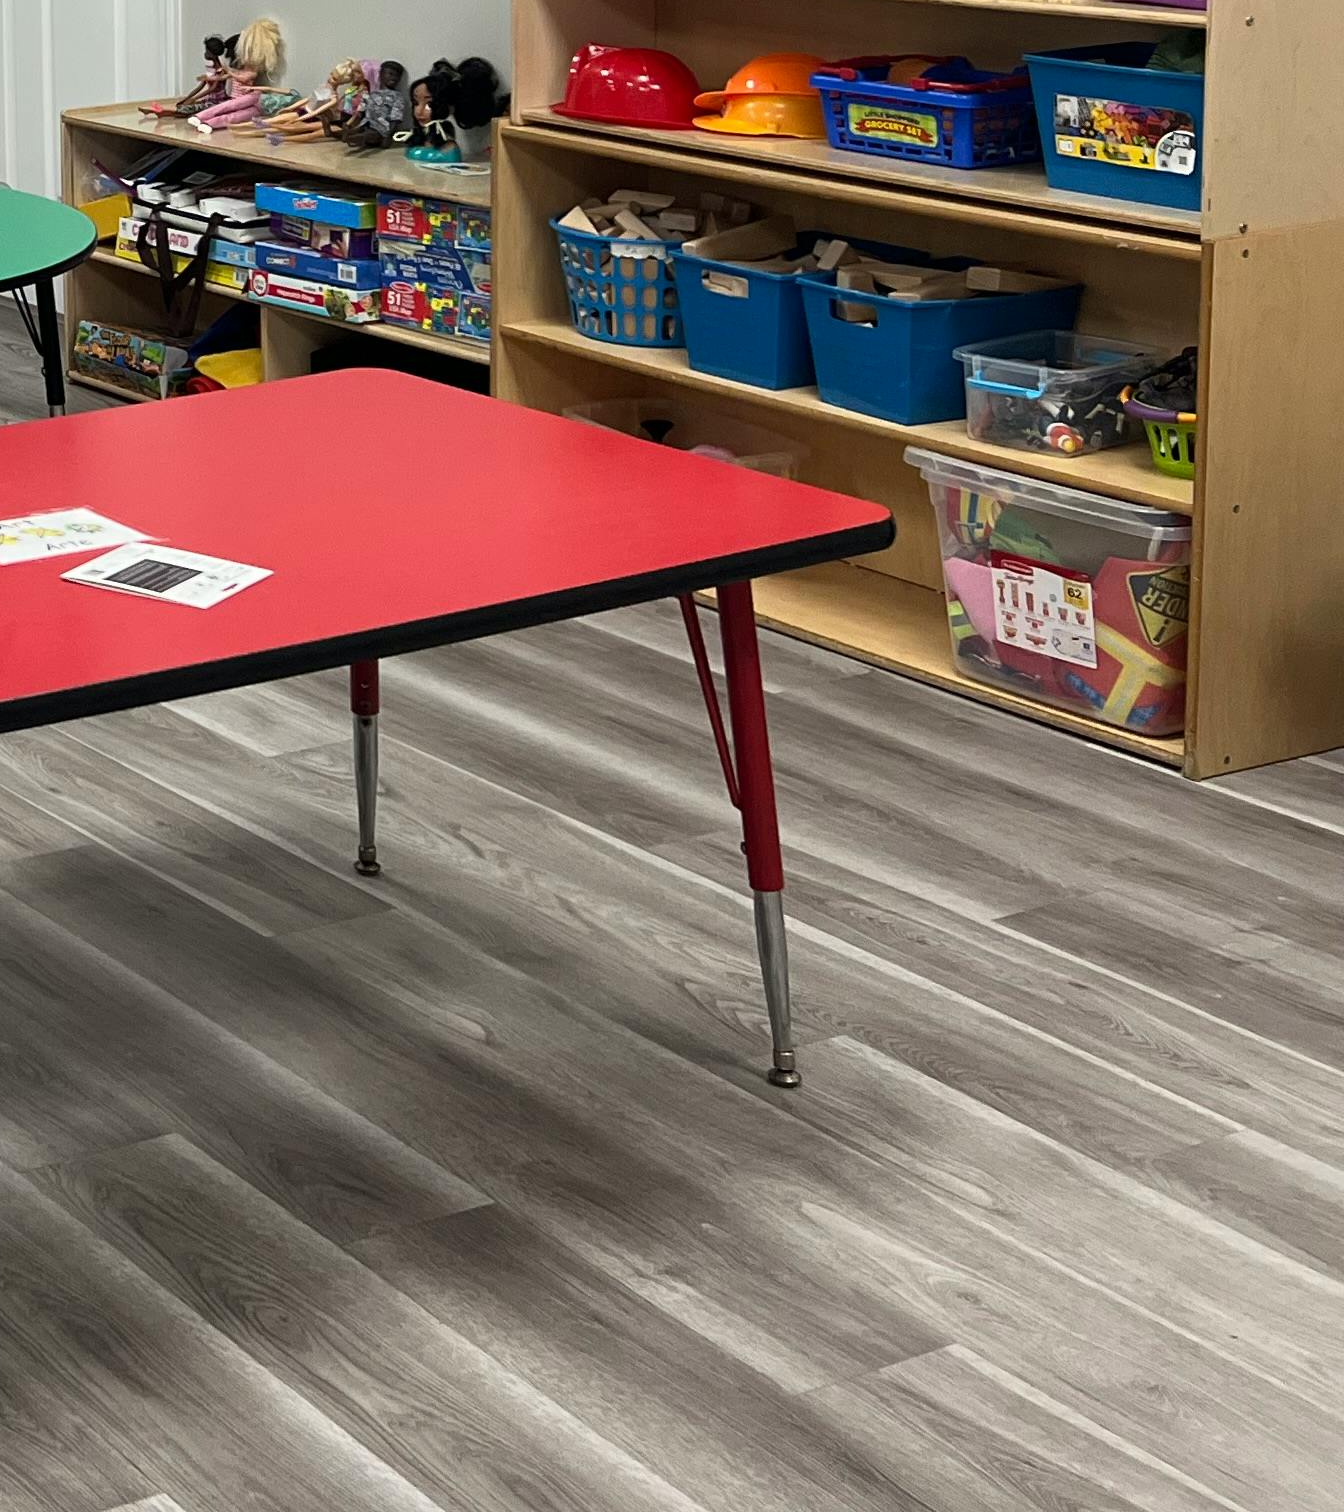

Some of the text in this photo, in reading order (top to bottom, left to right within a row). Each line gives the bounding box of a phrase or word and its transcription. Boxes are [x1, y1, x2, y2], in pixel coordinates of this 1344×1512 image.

[864, 120, 905, 131] GROCERY
[386, 209, 401, 224] 51
[387, 291, 401, 306] 51
[46, 538, 93, 552] Arte
[1067, 587, 1083, 600] 62
